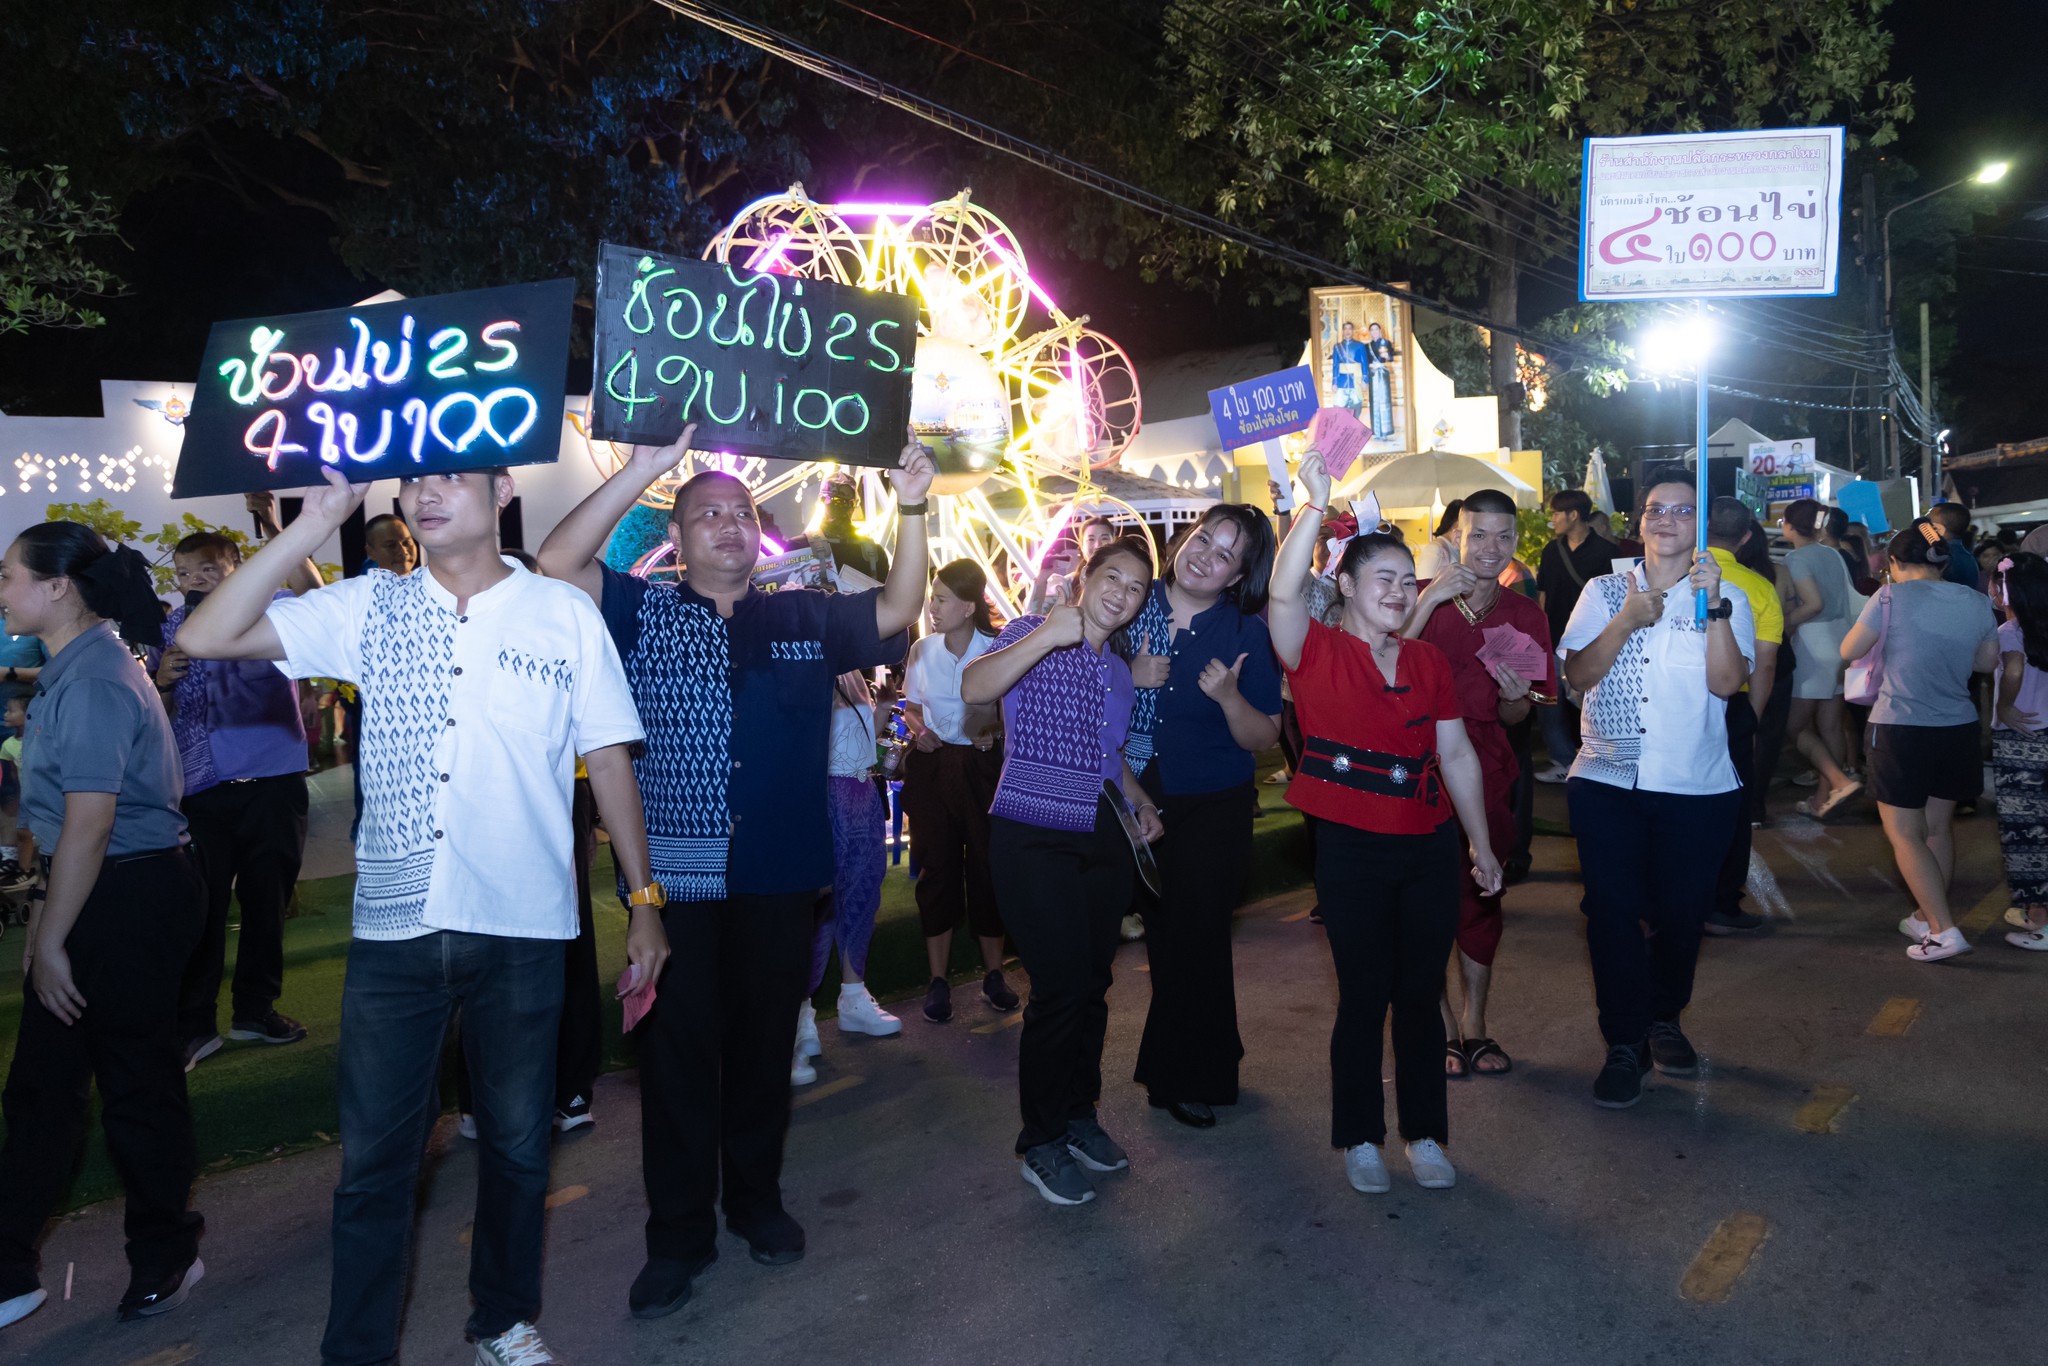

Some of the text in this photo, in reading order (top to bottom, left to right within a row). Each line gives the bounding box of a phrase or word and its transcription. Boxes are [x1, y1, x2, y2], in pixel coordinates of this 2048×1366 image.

[1599, 206, 1816, 265] ๔ ใบ ๑๐๐ บาท
[1664, 190, 1816, 225] ช้อนไข่
[605, 348, 660, 424] 4
[775, 379, 870, 435] 100
[1223, 381, 1307, 420] 4 ใบ 100 บาท
[403, 387, 539, 463] 100
